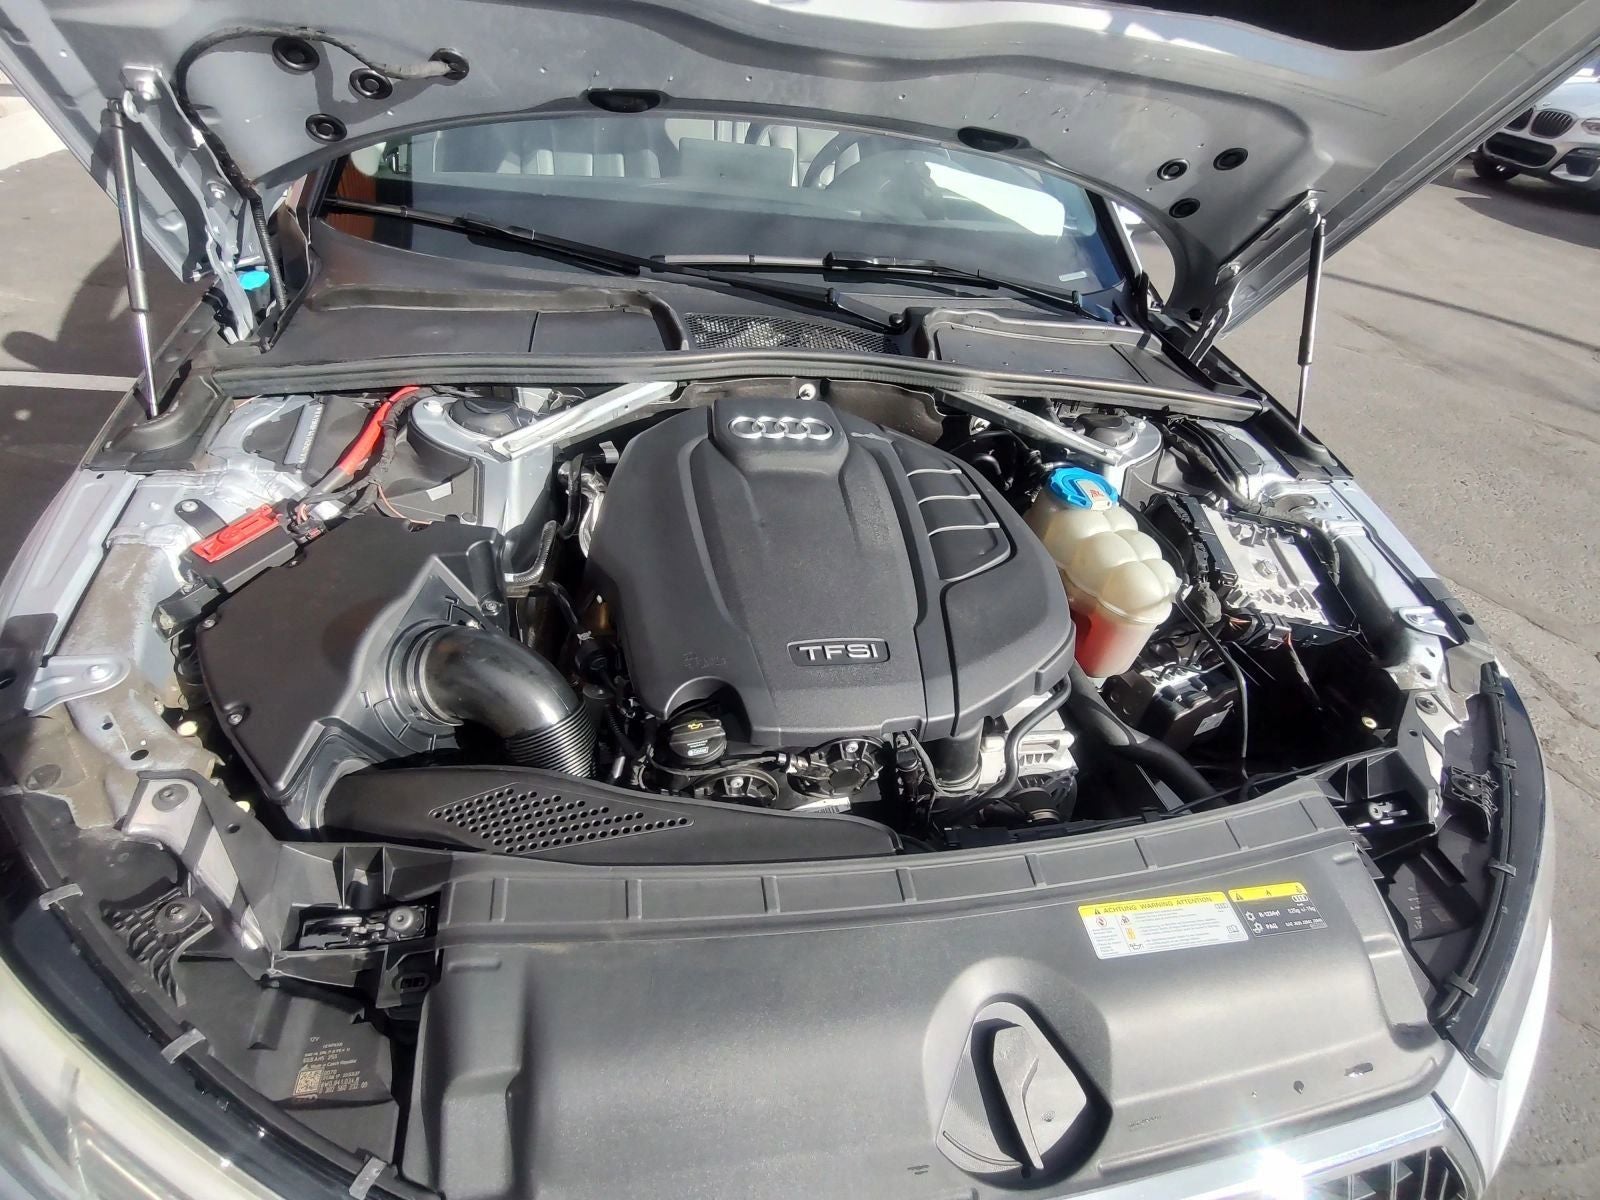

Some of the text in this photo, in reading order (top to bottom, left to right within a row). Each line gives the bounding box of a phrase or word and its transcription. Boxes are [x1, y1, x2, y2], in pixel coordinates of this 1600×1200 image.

[799, 643, 879, 661] TFSI
[1103, 896, 1213, 913] ACHTUNG WARNING ATTENTION
